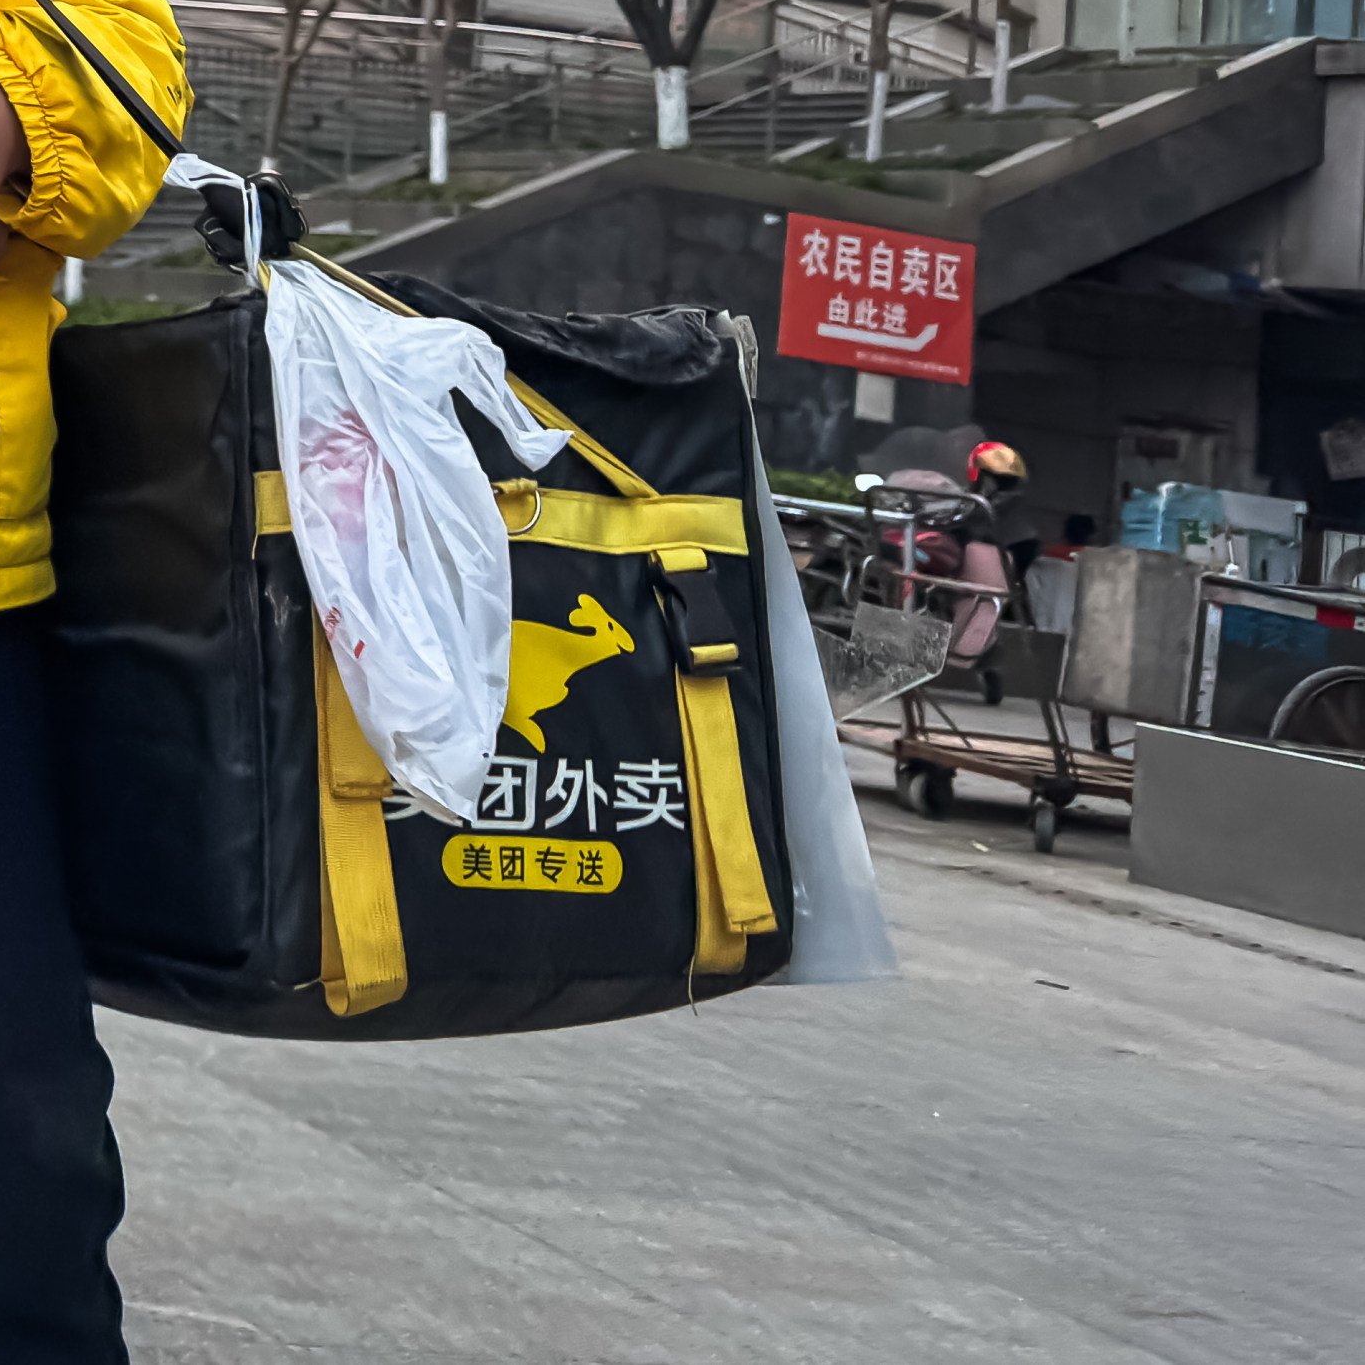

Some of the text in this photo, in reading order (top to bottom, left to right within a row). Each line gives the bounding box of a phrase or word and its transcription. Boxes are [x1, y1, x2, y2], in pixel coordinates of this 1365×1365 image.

[800, 228, 961, 302] 农民自卖区
[828, 291, 908, 335] 由此进
[462, 842, 605, 886] 美团专送
